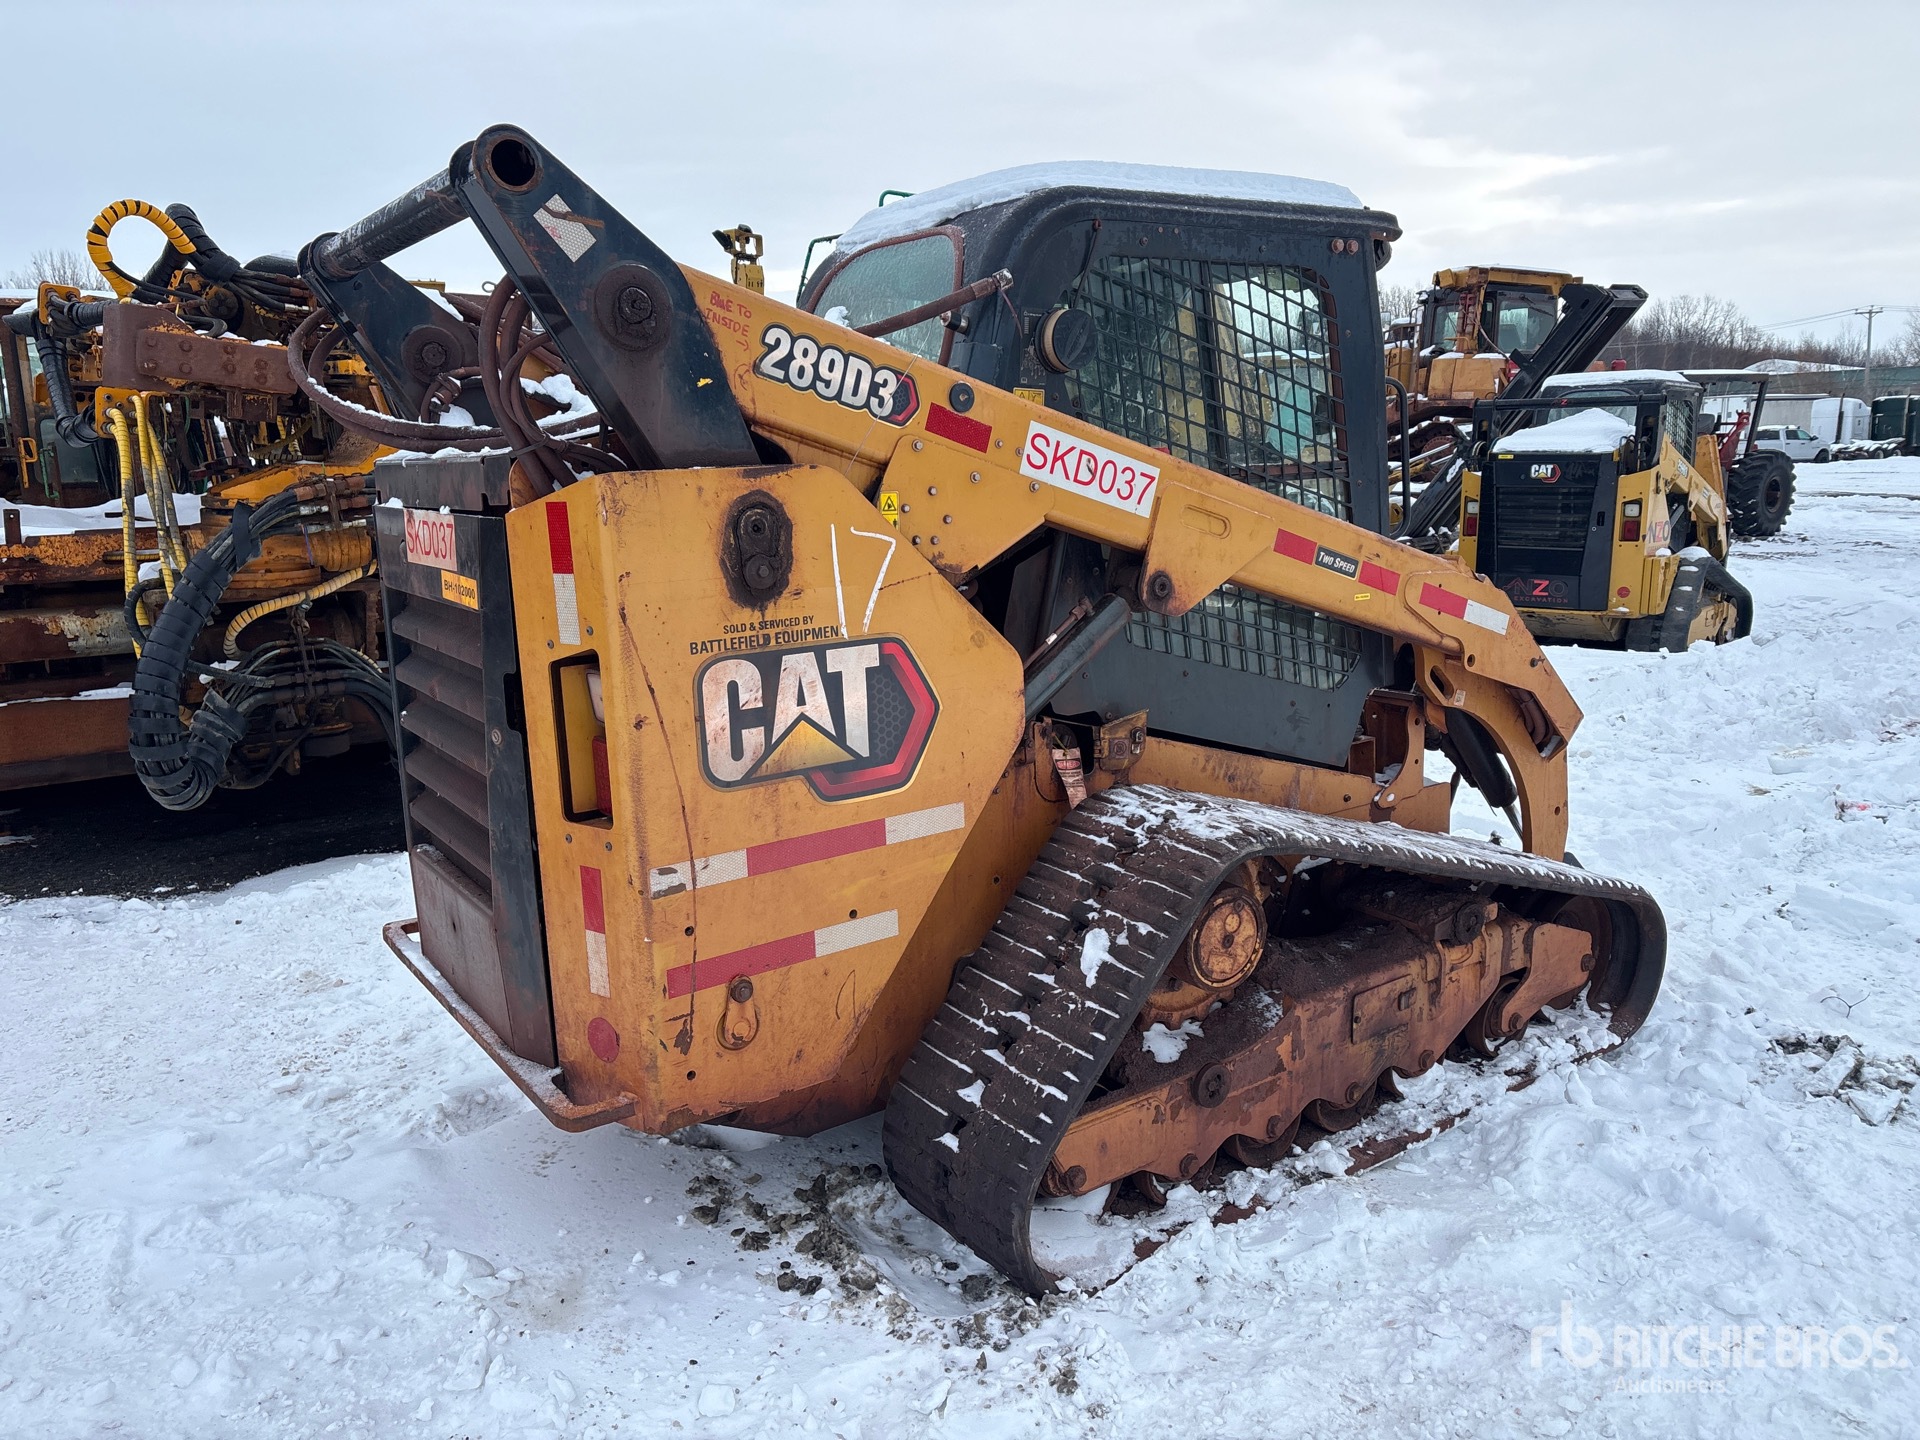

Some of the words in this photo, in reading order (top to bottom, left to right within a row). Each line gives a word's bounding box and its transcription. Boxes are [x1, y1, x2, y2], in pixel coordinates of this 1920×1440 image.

[705, 308, 750, 338] INSIDE
[737, 303, 752, 319] TO
[758, 327, 898, 417] 289D3
[1026, 433, 1156, 506] SKD037
[1531, 464, 1554, 479] CAT
[406, 519, 453, 560] SKD037
[444, 580, 475, 600] BH-102000
[830, 523, 897, 640] 17
[1513, 595, 1569, 604] EXCAVATION
[723, 622, 747, 634] SOLD
[749, 621, 757, 632] &
[758, 618, 800, 631] SERVICED
[802, 615, 815, 626] BY
[690, 632, 772, 655] BATTLEFIELD
[775, 625, 847, 645] EQUIPMEN
[702, 643, 880, 782] CAT
